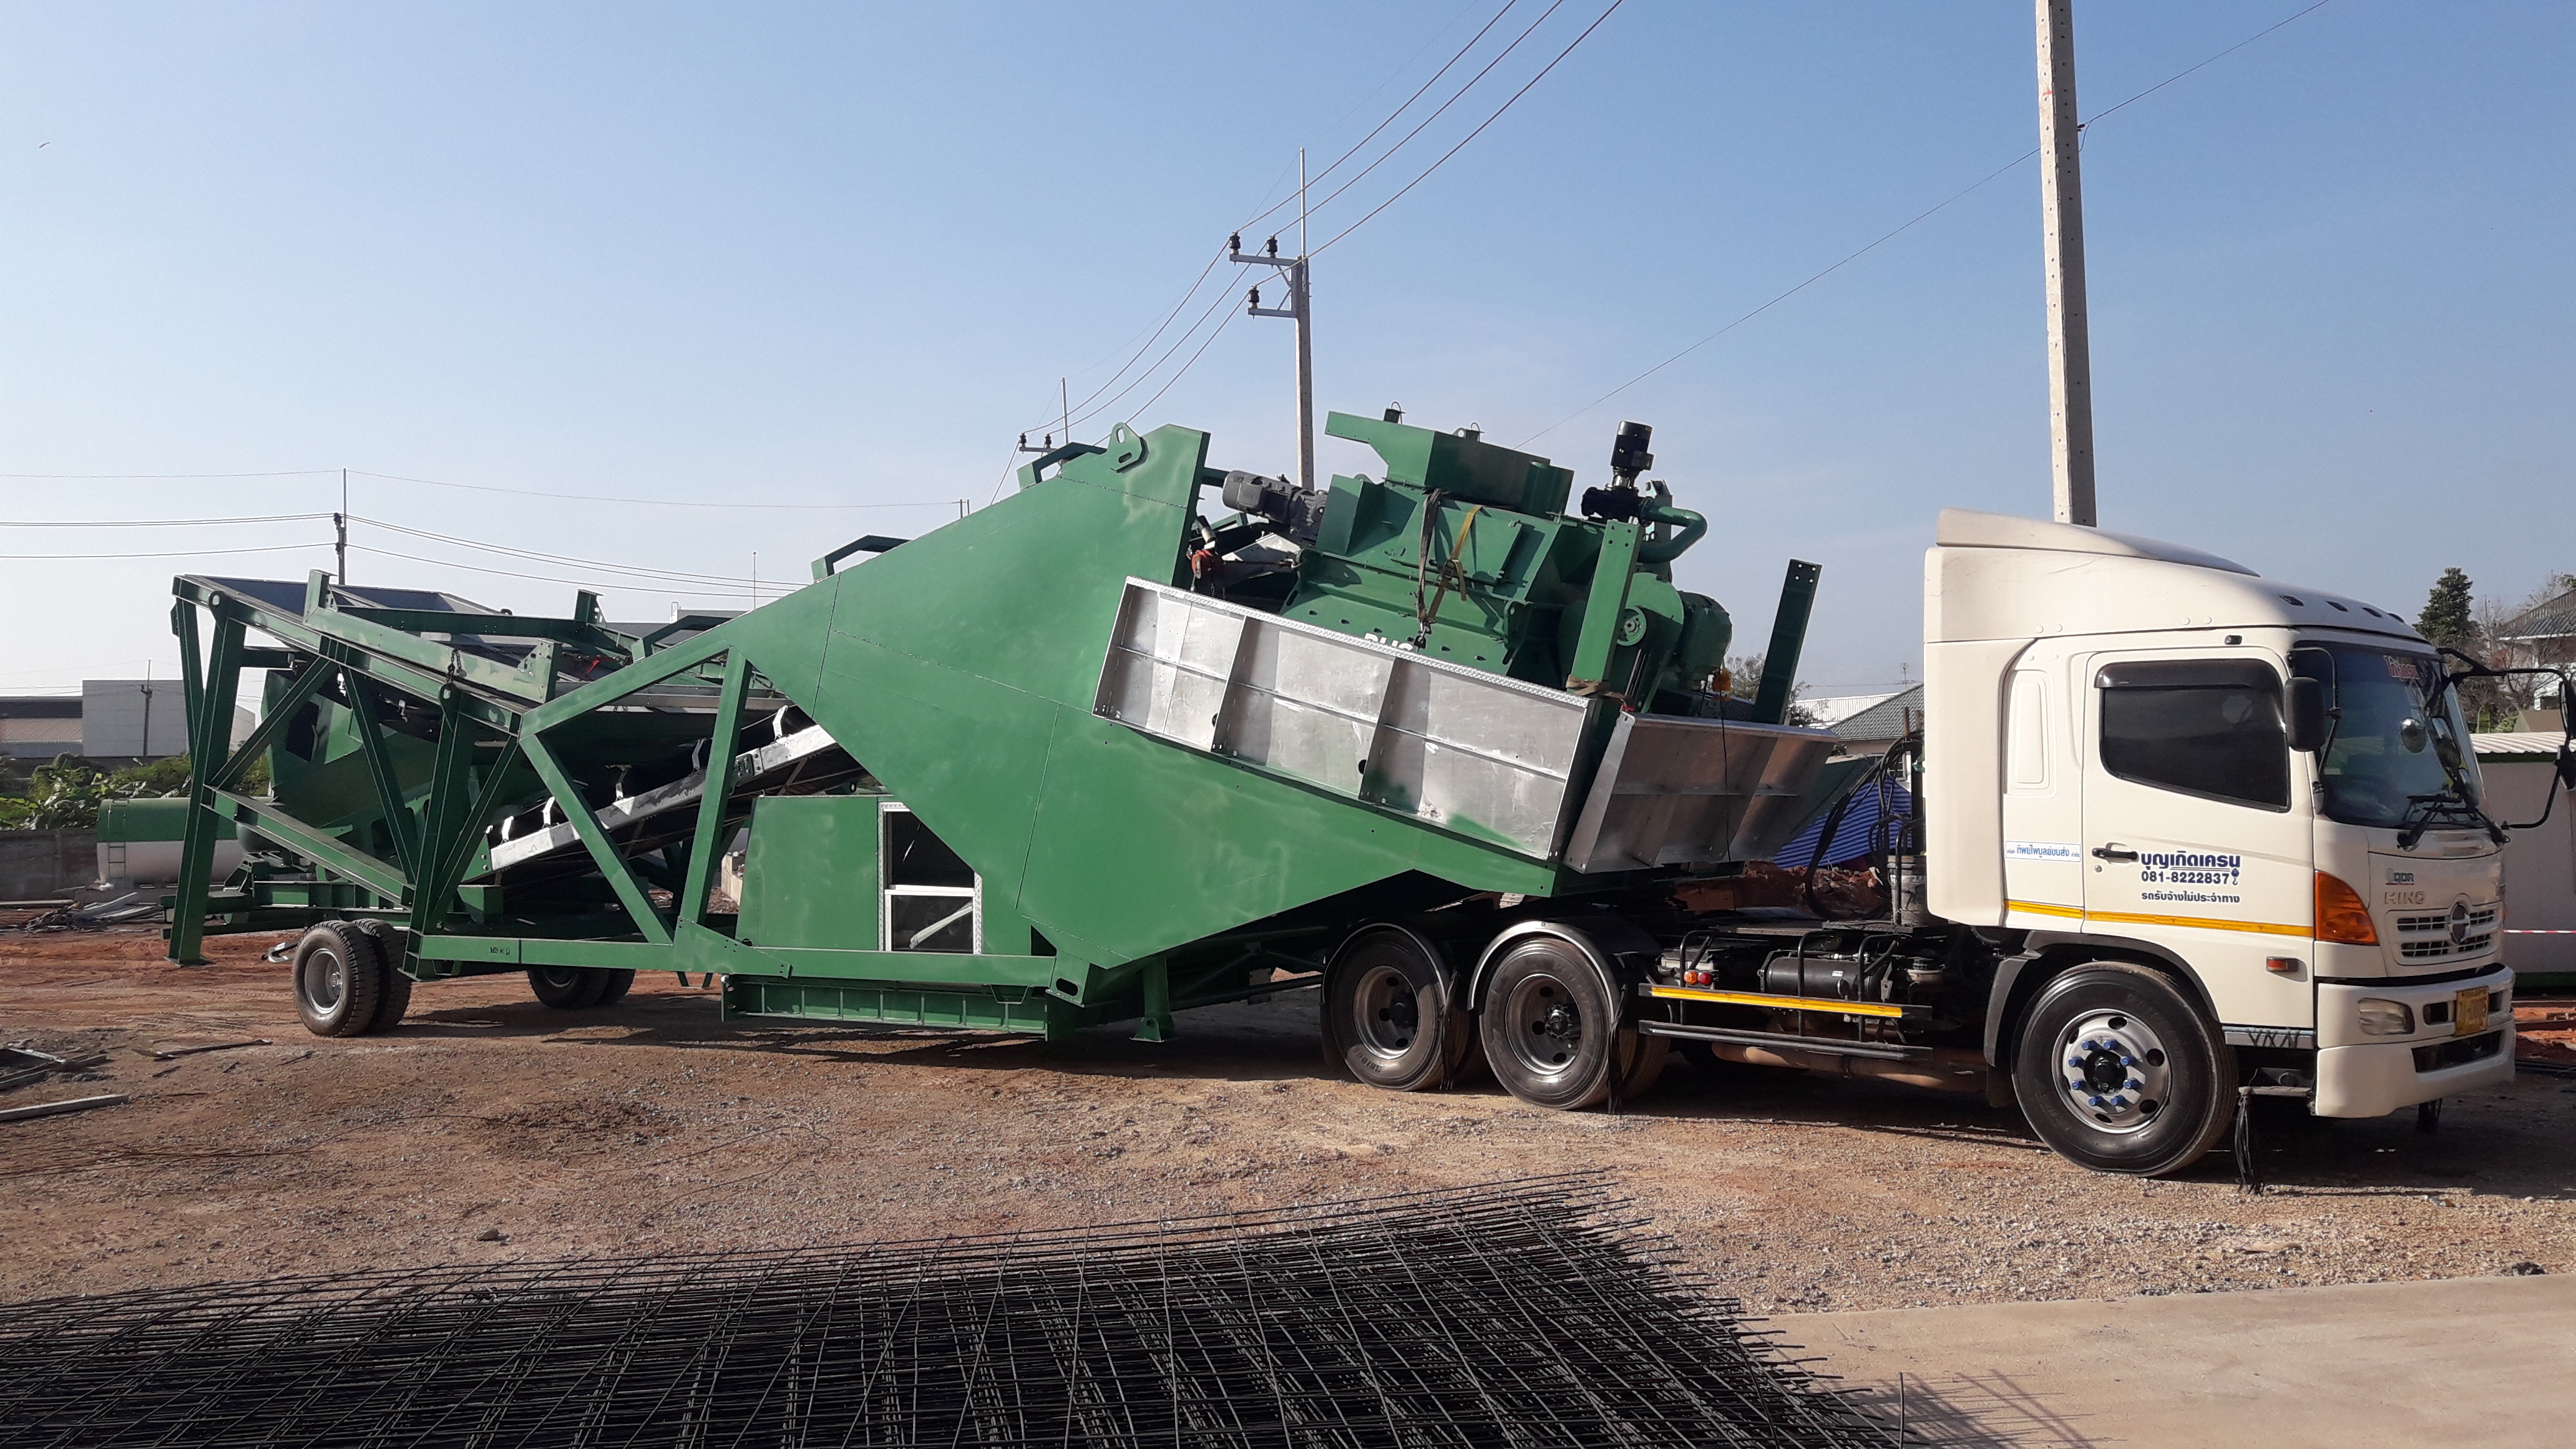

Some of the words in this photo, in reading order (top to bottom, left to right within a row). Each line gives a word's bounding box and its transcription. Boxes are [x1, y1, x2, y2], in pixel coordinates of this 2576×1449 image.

[2141, 850, 2241, 870] บุญเกิดเครน
[2141, 871, 2230, 884] 081-8222837
[2141, 890, 2240, 903] รถรับจ้างไม่ประจำทาง
[2384, 890, 2426, 905] HINO
